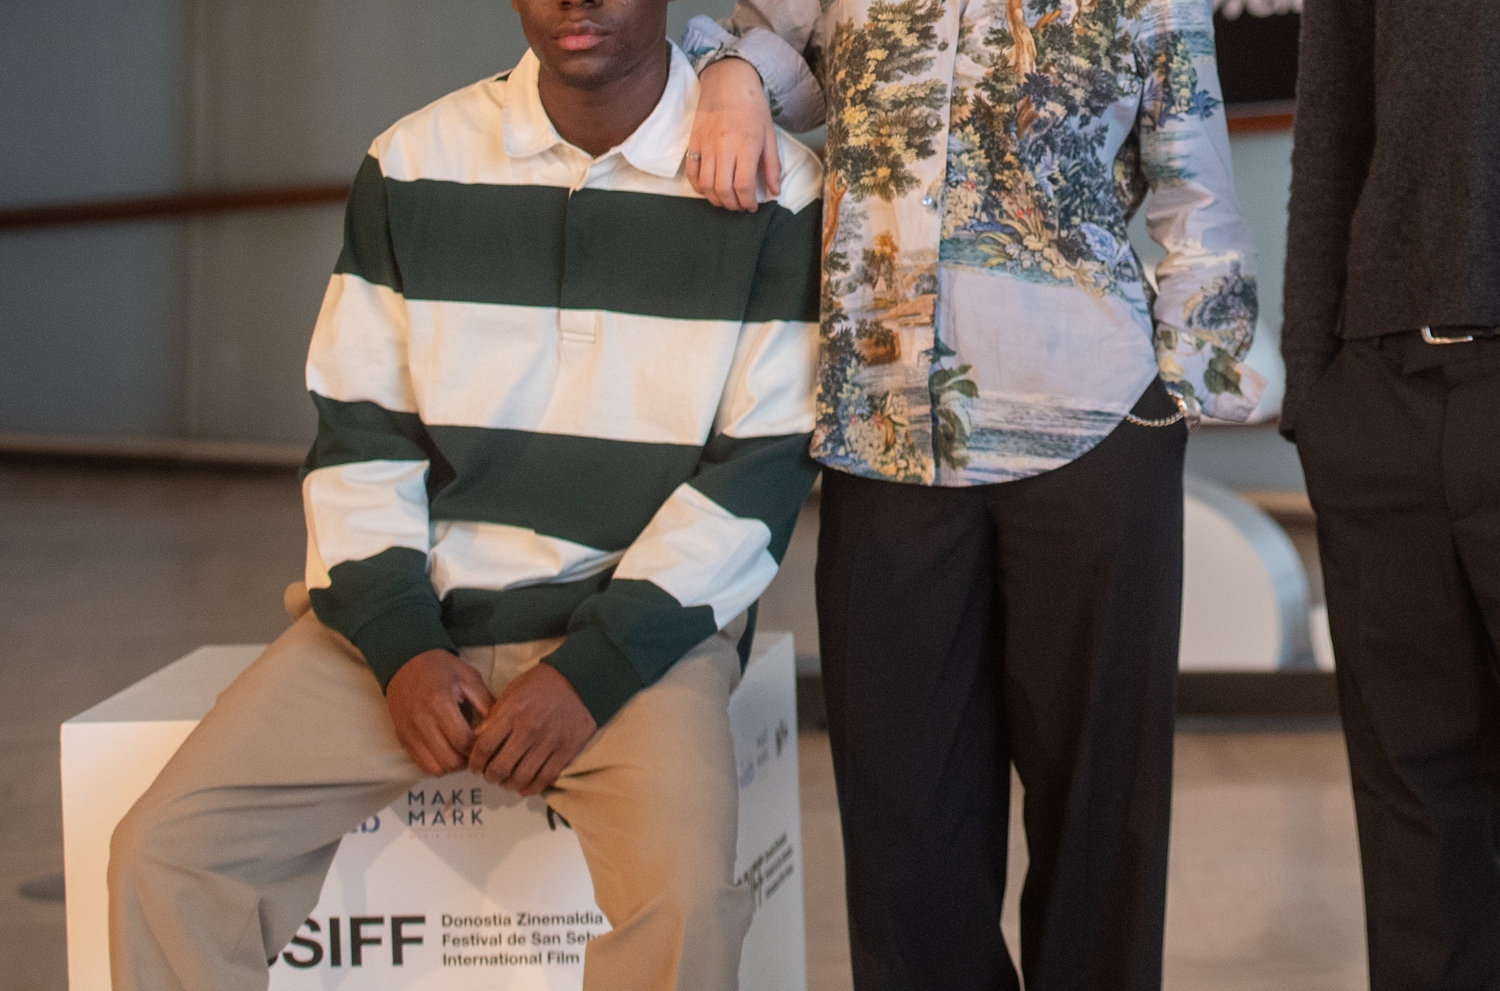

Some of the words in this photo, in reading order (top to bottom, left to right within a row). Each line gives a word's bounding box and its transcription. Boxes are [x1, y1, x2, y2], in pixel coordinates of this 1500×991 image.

[407, 787, 484, 807] MAKE
[407, 808, 484, 827] MARK
[441, 913, 512, 928] Donostia
[516, 912, 603, 927] Zinemaldia
[268, 914, 427, 970] SIFF
[442, 932, 502, 947] Festival
[507, 932, 527, 946] de
[531, 931, 561, 946] San
[442, 953, 542, 967] International
[547, 951, 580, 965] Film
